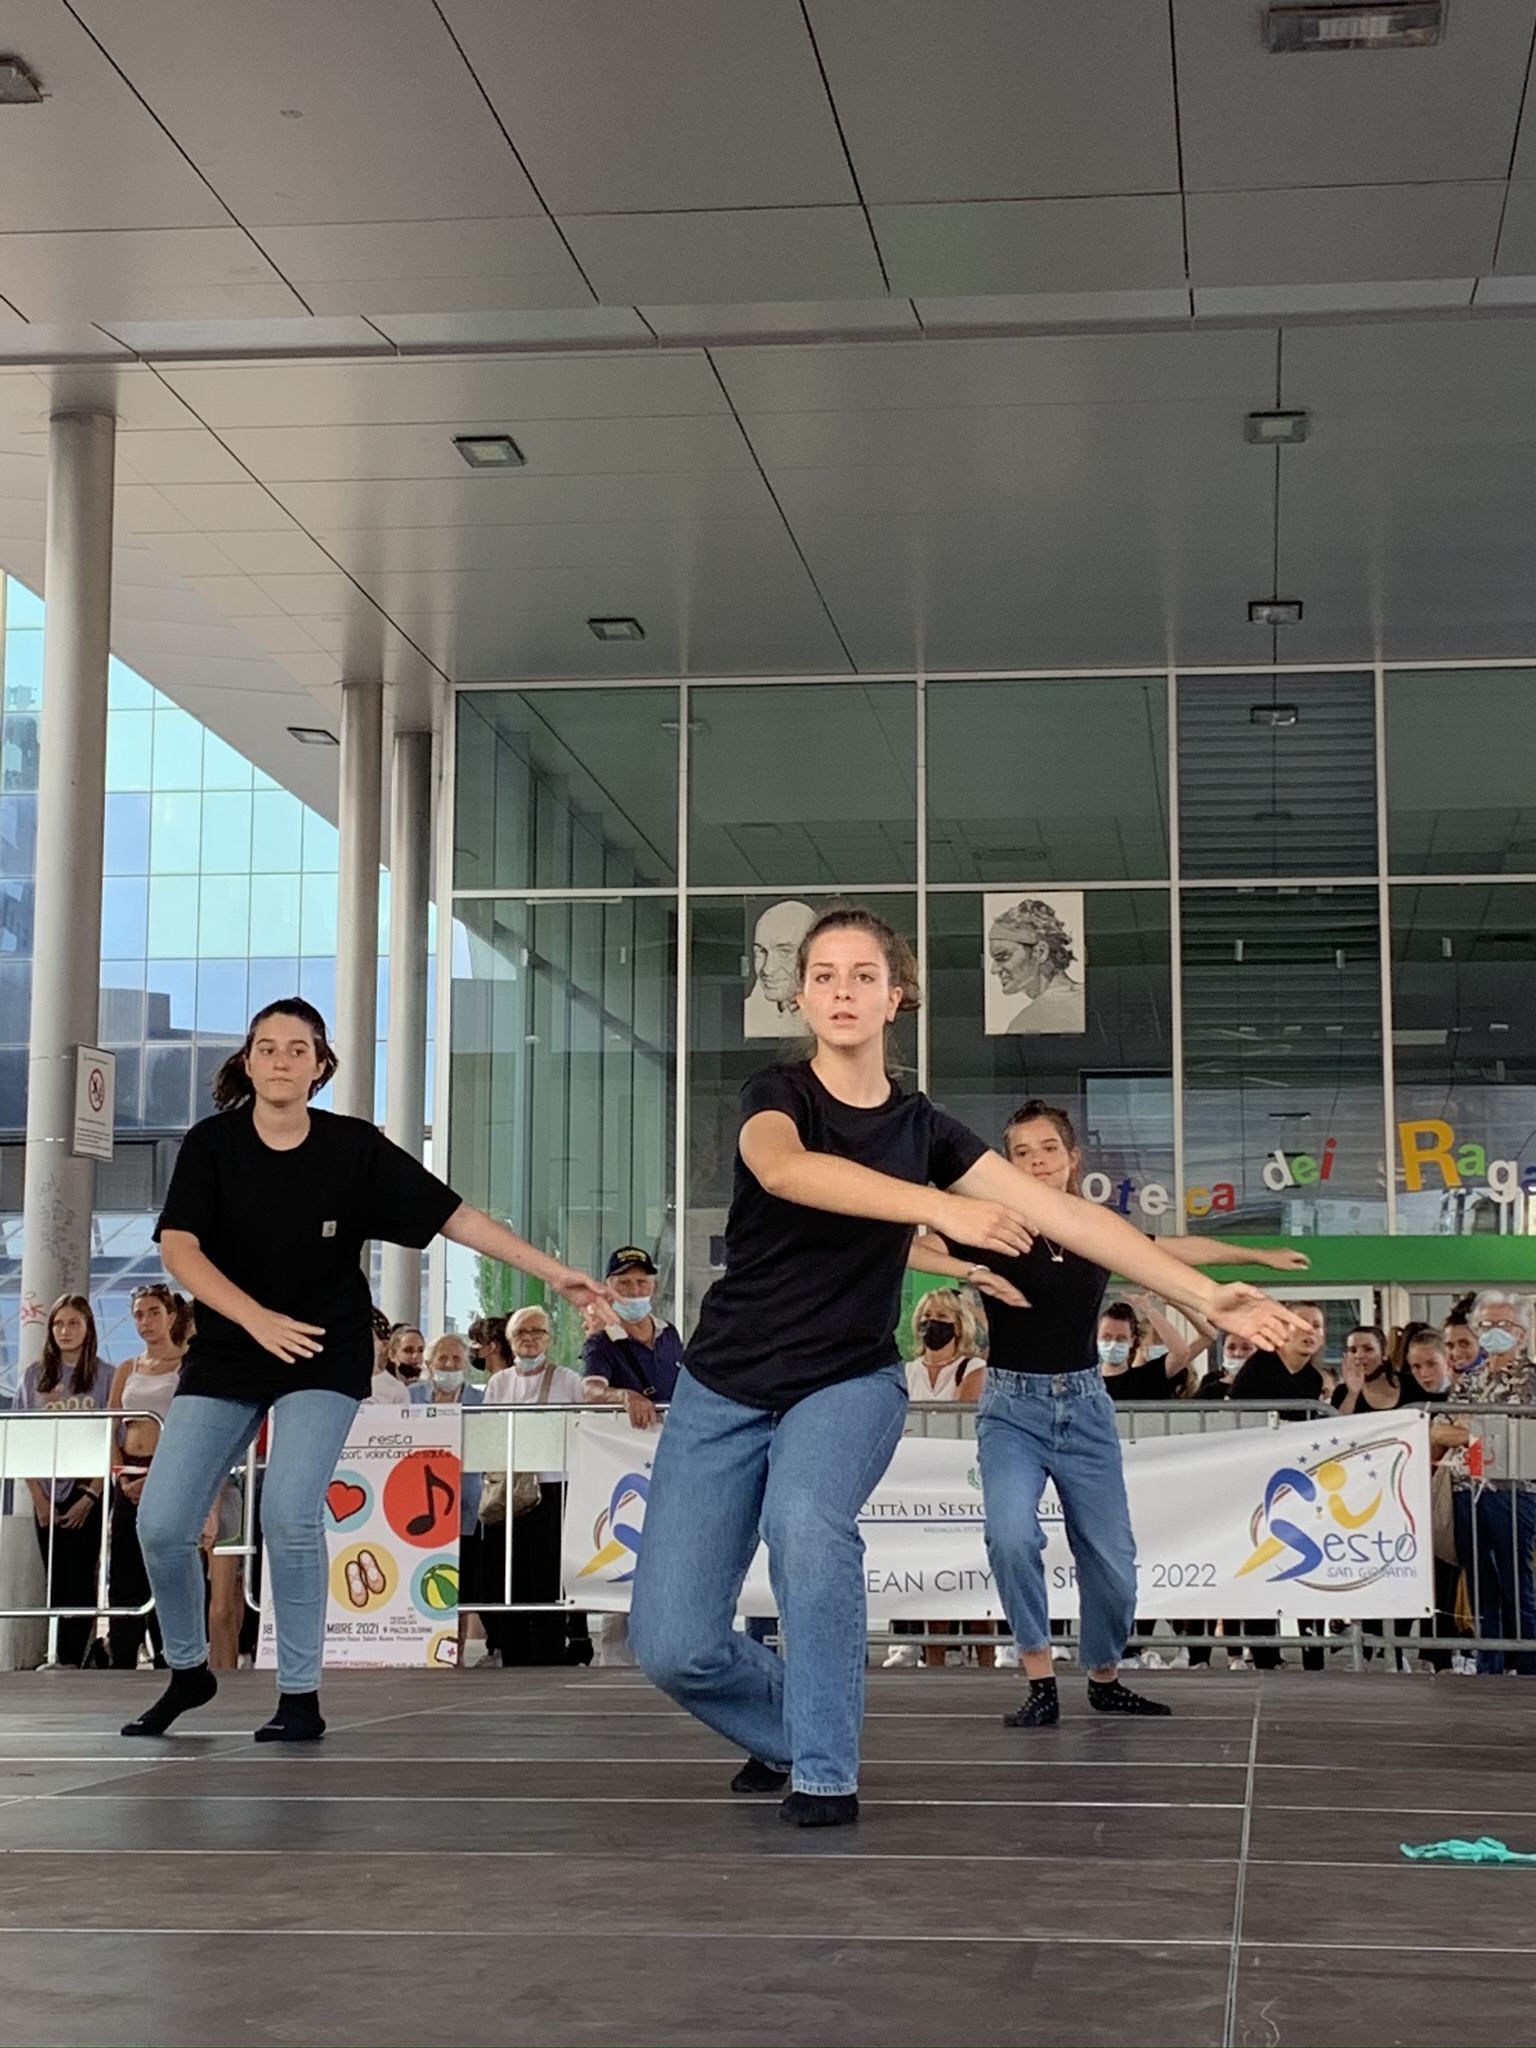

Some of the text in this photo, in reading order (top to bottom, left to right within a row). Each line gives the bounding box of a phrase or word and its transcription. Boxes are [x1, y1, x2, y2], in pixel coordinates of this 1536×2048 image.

[1263, 1138, 1337, 1190] dei
[867, 1570, 924, 1593] EAN
[934, 1570, 995, 1592] CITY
[1151, 1563, 1217, 1588] 2022
[356, 1622, 379, 1634] 2021
